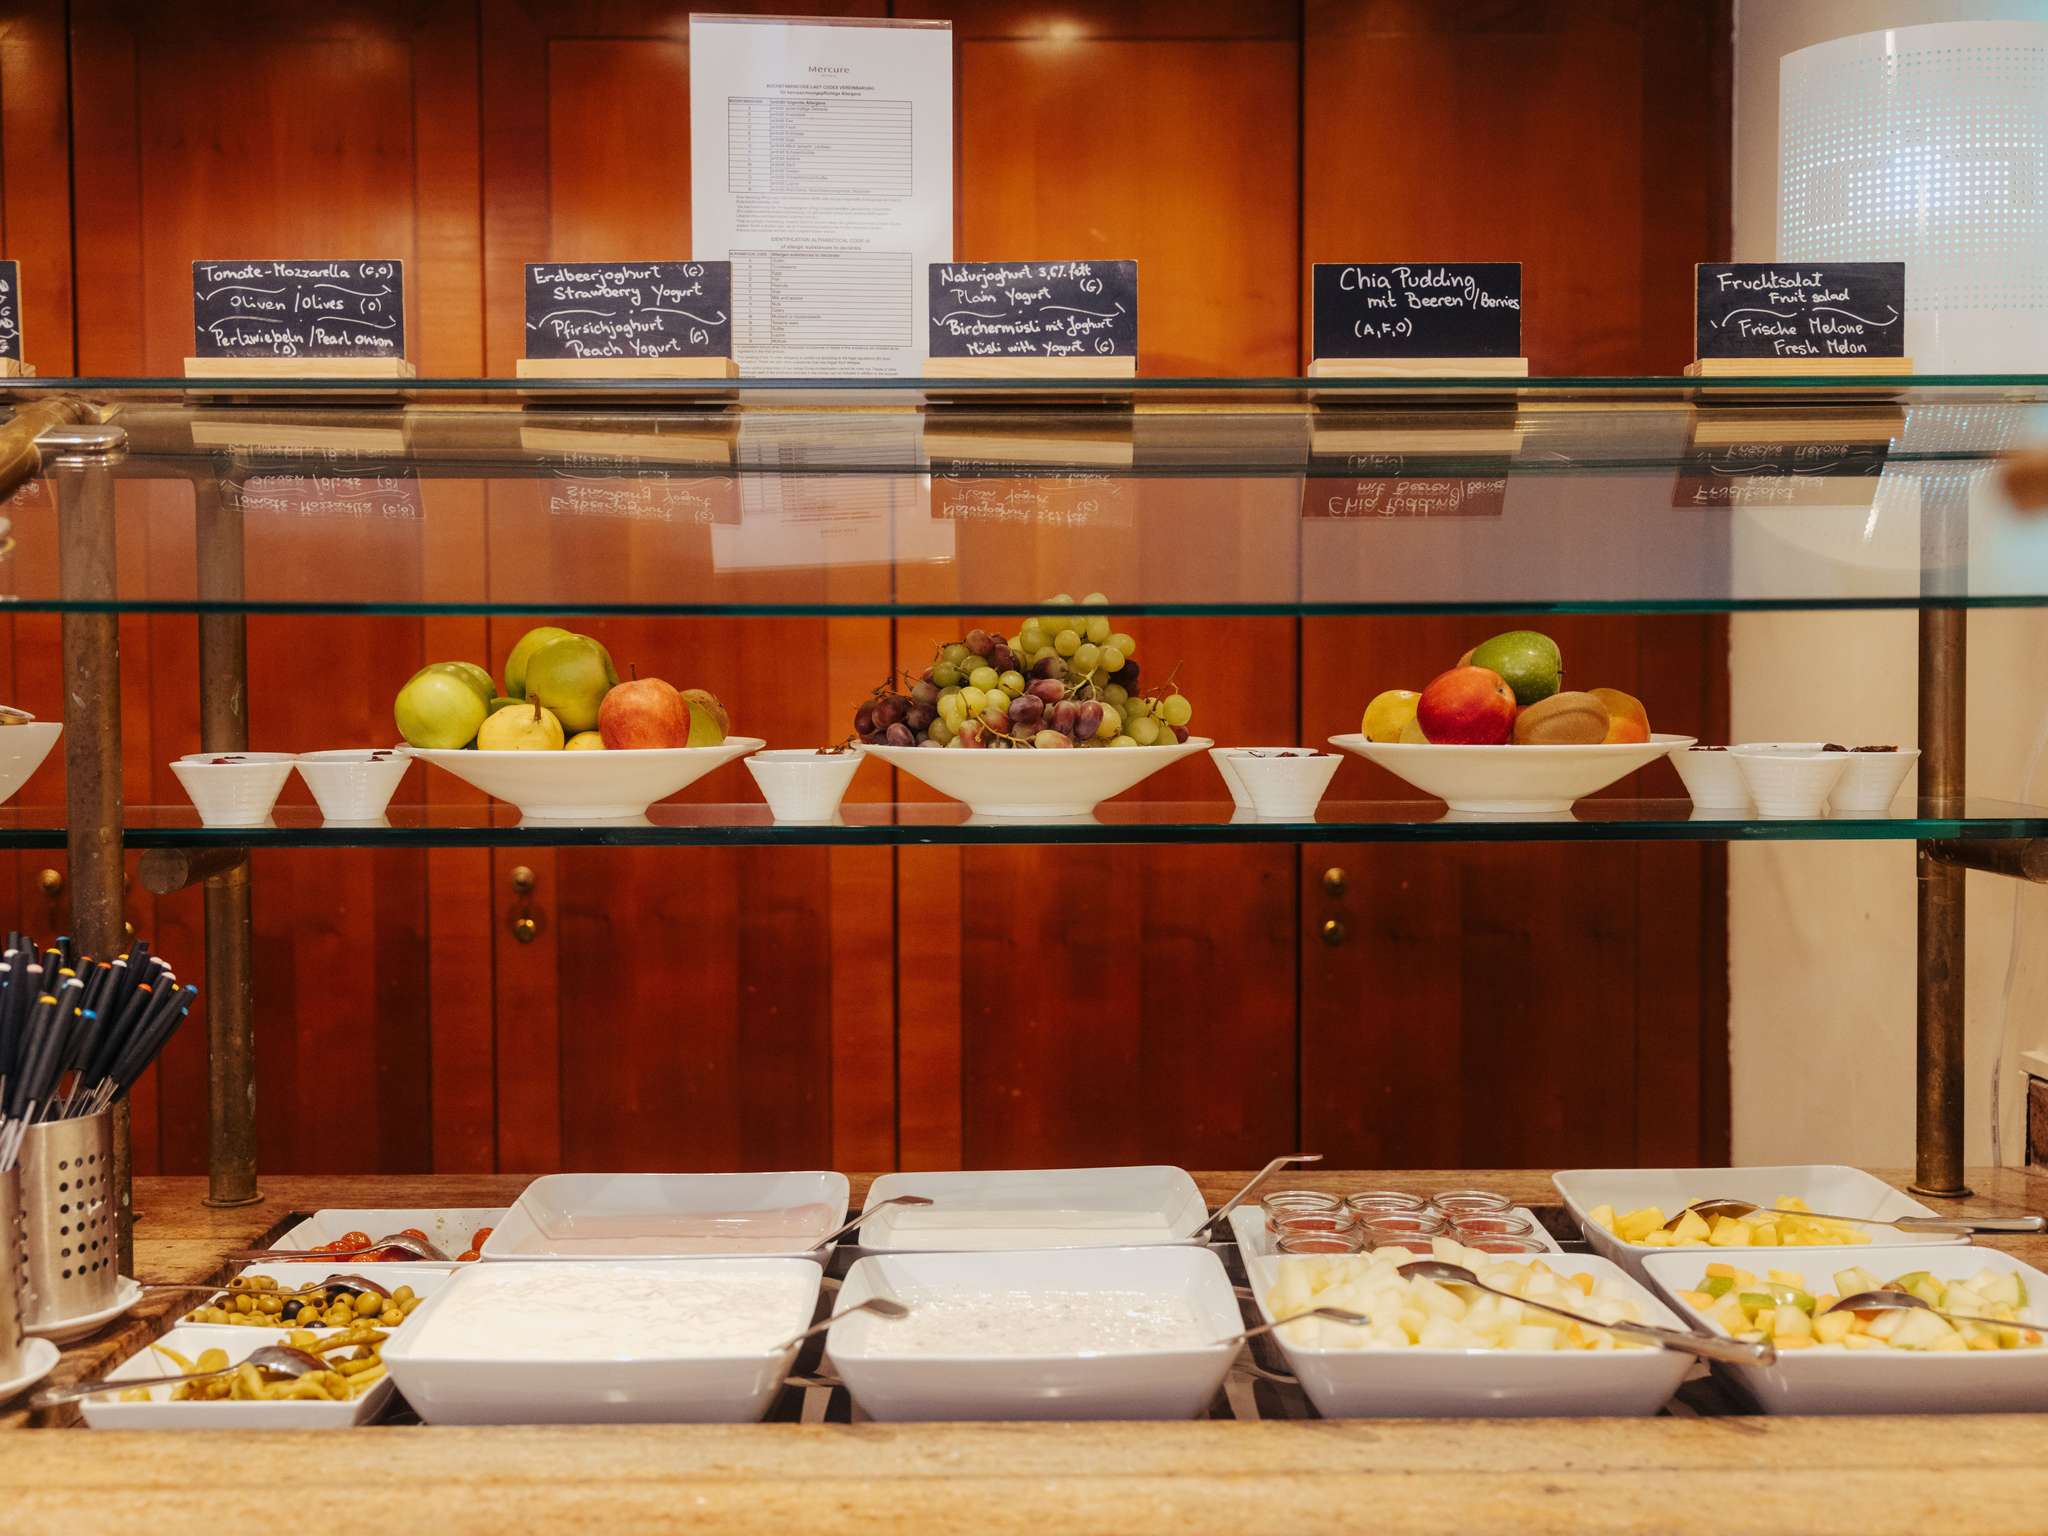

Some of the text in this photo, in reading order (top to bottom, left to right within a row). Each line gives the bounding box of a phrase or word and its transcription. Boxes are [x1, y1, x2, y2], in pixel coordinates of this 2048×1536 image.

[808, 65, 850, 74] Mercure
[533, 266, 662, 287] Erdbeerjoghurt
[941, 265, 1032, 288] Naturjoghurt
[1340, 267, 1476, 300] Chia Pudding
[1717, 271, 1823, 291] Fruchtsalat
[230, 296, 286, 310] Oliven
[553, 282, 703, 306] Strawberry Yogurt
[950, 288, 1051, 306] Plain Yogurt
[1367, 291, 1397, 308] mit
[1405, 292, 1463, 309] Beeren
[1768, 289, 1850, 305] Fruit salad
[551, 316, 664, 339] Pfirsichjoghurt
[1045, 321, 1064, 332] mit
[1738, 318, 1865, 337] Frische Melone
[566, 338, 681, 358] Peach Yogurt
[1774, 339, 1867, 355] Fresh Melon
